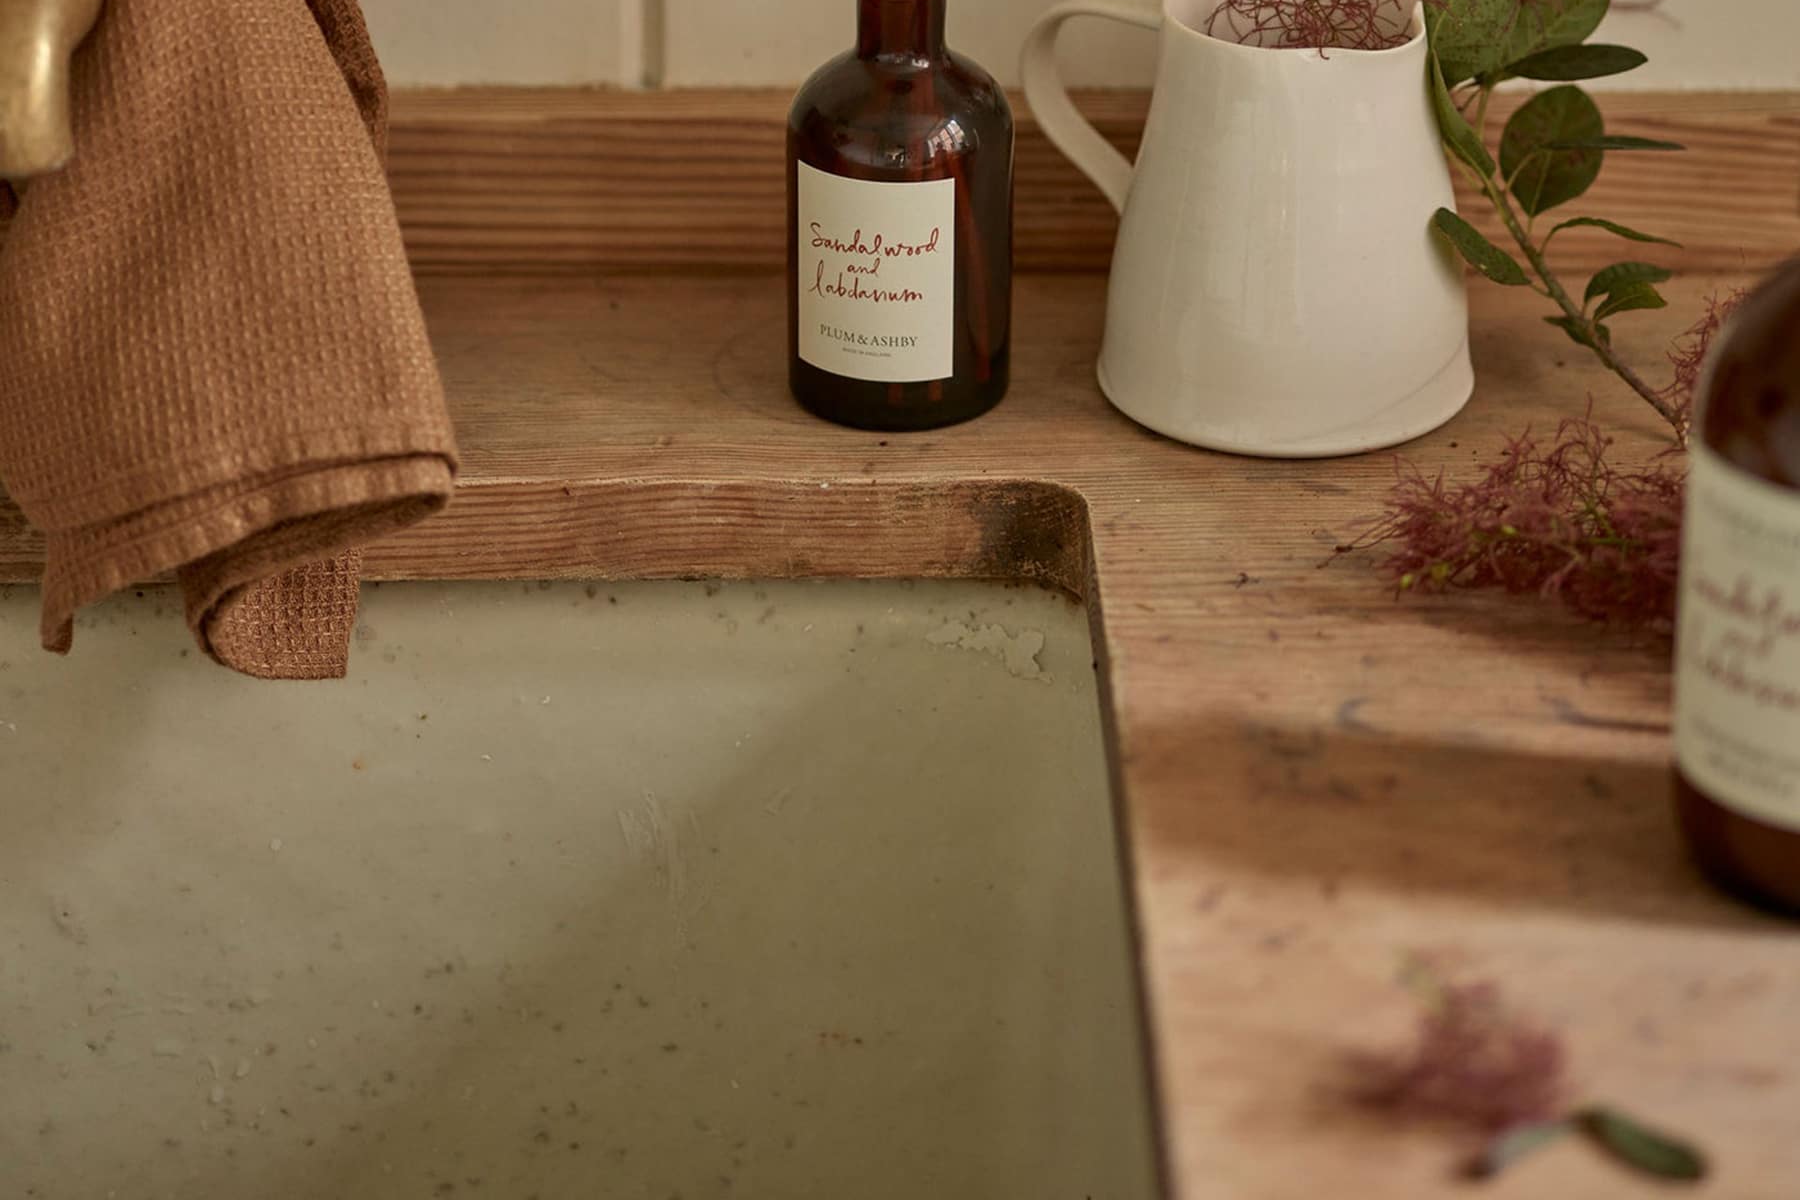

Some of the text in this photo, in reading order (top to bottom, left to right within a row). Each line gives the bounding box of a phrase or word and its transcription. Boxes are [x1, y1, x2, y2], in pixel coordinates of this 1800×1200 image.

[810, 222, 939, 256] Sandalwood
[810, 260, 923, 303] labdanum
[847, 258, 880, 276] and
